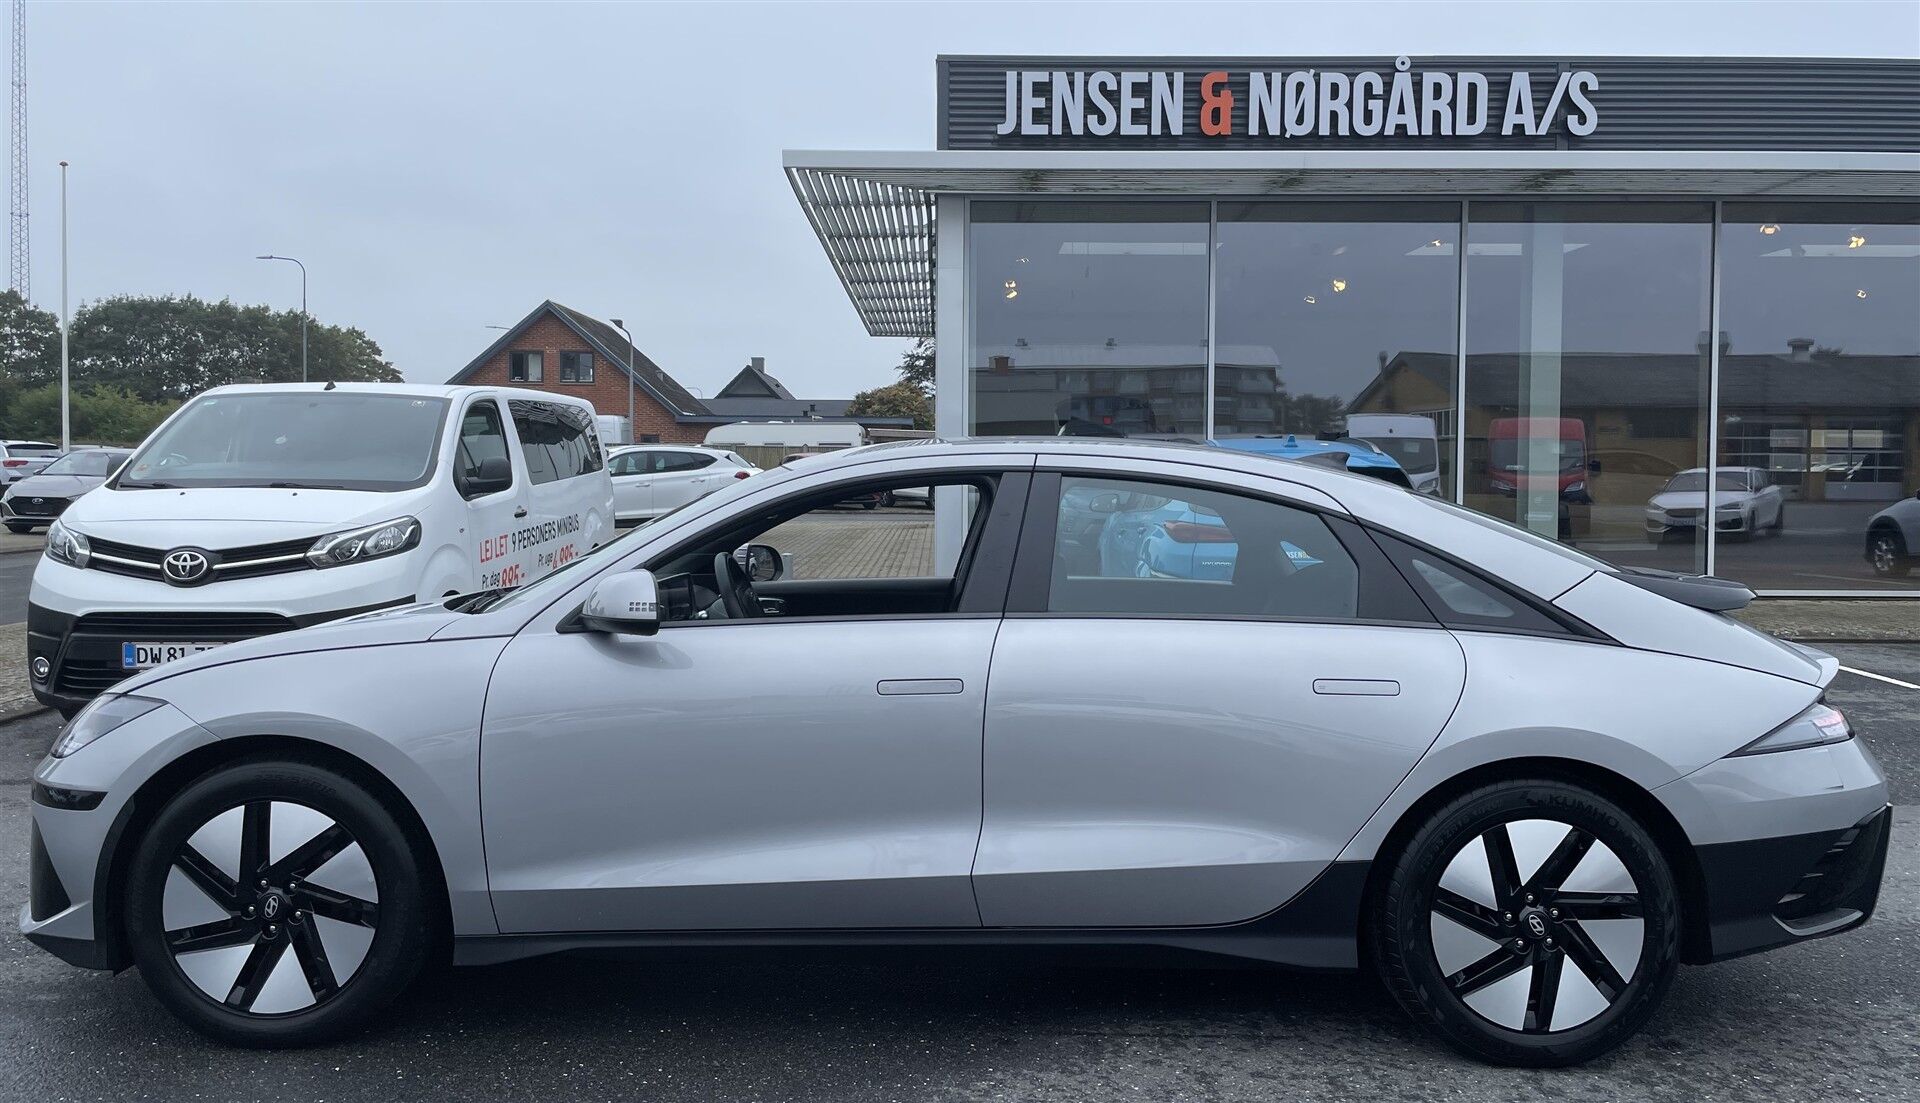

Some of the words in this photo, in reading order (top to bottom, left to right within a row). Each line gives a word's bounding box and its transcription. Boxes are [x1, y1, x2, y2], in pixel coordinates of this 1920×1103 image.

[997, 71, 1184, 136] JENSEN
[1200, 71, 1234, 136] &
[1248, 55, 1488, 138] NØRGÅRD
[1501, 71, 1599, 136] A/S
[495, 534, 508, 558] LET
[512, 532, 517, 552] 9
[517, 521, 556, 551] PERSONERS
[557, 513, 580, 537] MINIBUS
[490, 571, 501, 587] dag
[136, 647, 162, 663] DW
[167, 647, 185, 662] 81
[1550, 794, 1619, 829] KUMHO
